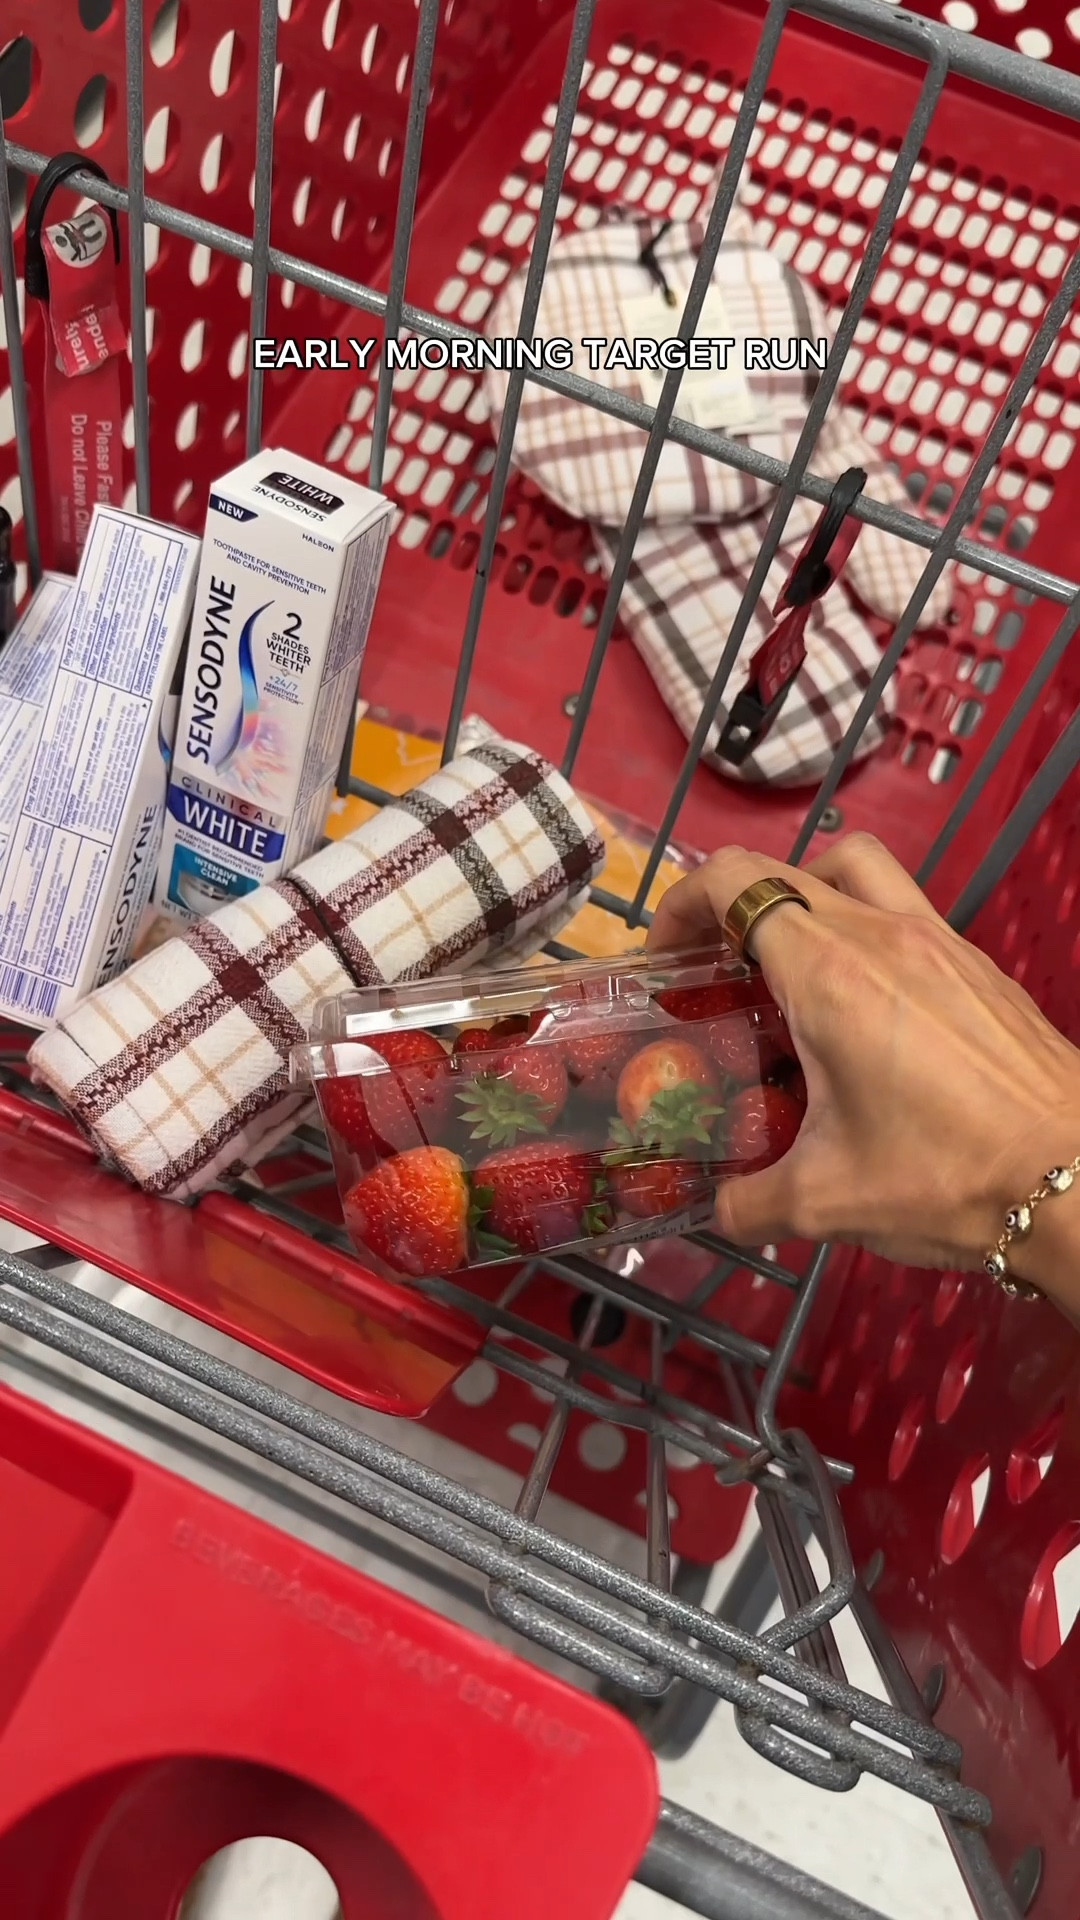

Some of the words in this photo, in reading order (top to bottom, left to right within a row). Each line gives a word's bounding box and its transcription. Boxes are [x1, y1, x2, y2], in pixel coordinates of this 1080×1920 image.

[71, 414, 87, 435] Do
[72, 438, 87, 462] not
[96, 421, 112, 471] Please
[73, 465, 88, 506] Leave
[278, 474, 335, 505] WHITE
[218, 500, 244, 519] NEW
[251, 485, 327, 522] SENSODYNE
[213, 538, 255, 564] TOOTHPASTE
[256, 559, 270, 570] FOR
[271, 564, 304, 586] SENSITIVE
[306, 580, 327, 595] TEETH
[226, 553, 241, 565] AND
[242, 558, 266, 576] CAVITY
[268, 572, 310, 595] PREVENTION
[283, 612, 302, 640] 2
[266, 638, 311, 666] WHITER
[271, 632, 309, 654] SHADES
[186, 575, 236, 765] SENSODYNE
[270, 651, 305, 674] TEETH
[265, 682, 298, 699] SENSITIVITY
[182, 776, 276, 827] CLINICAL
[183, 795, 268, 858] WHITE
[195, 857, 238, 882] INTENSIVE
[200, 869, 228, 886] CLEAN
[97, 805, 158, 988] ENSODYNE
